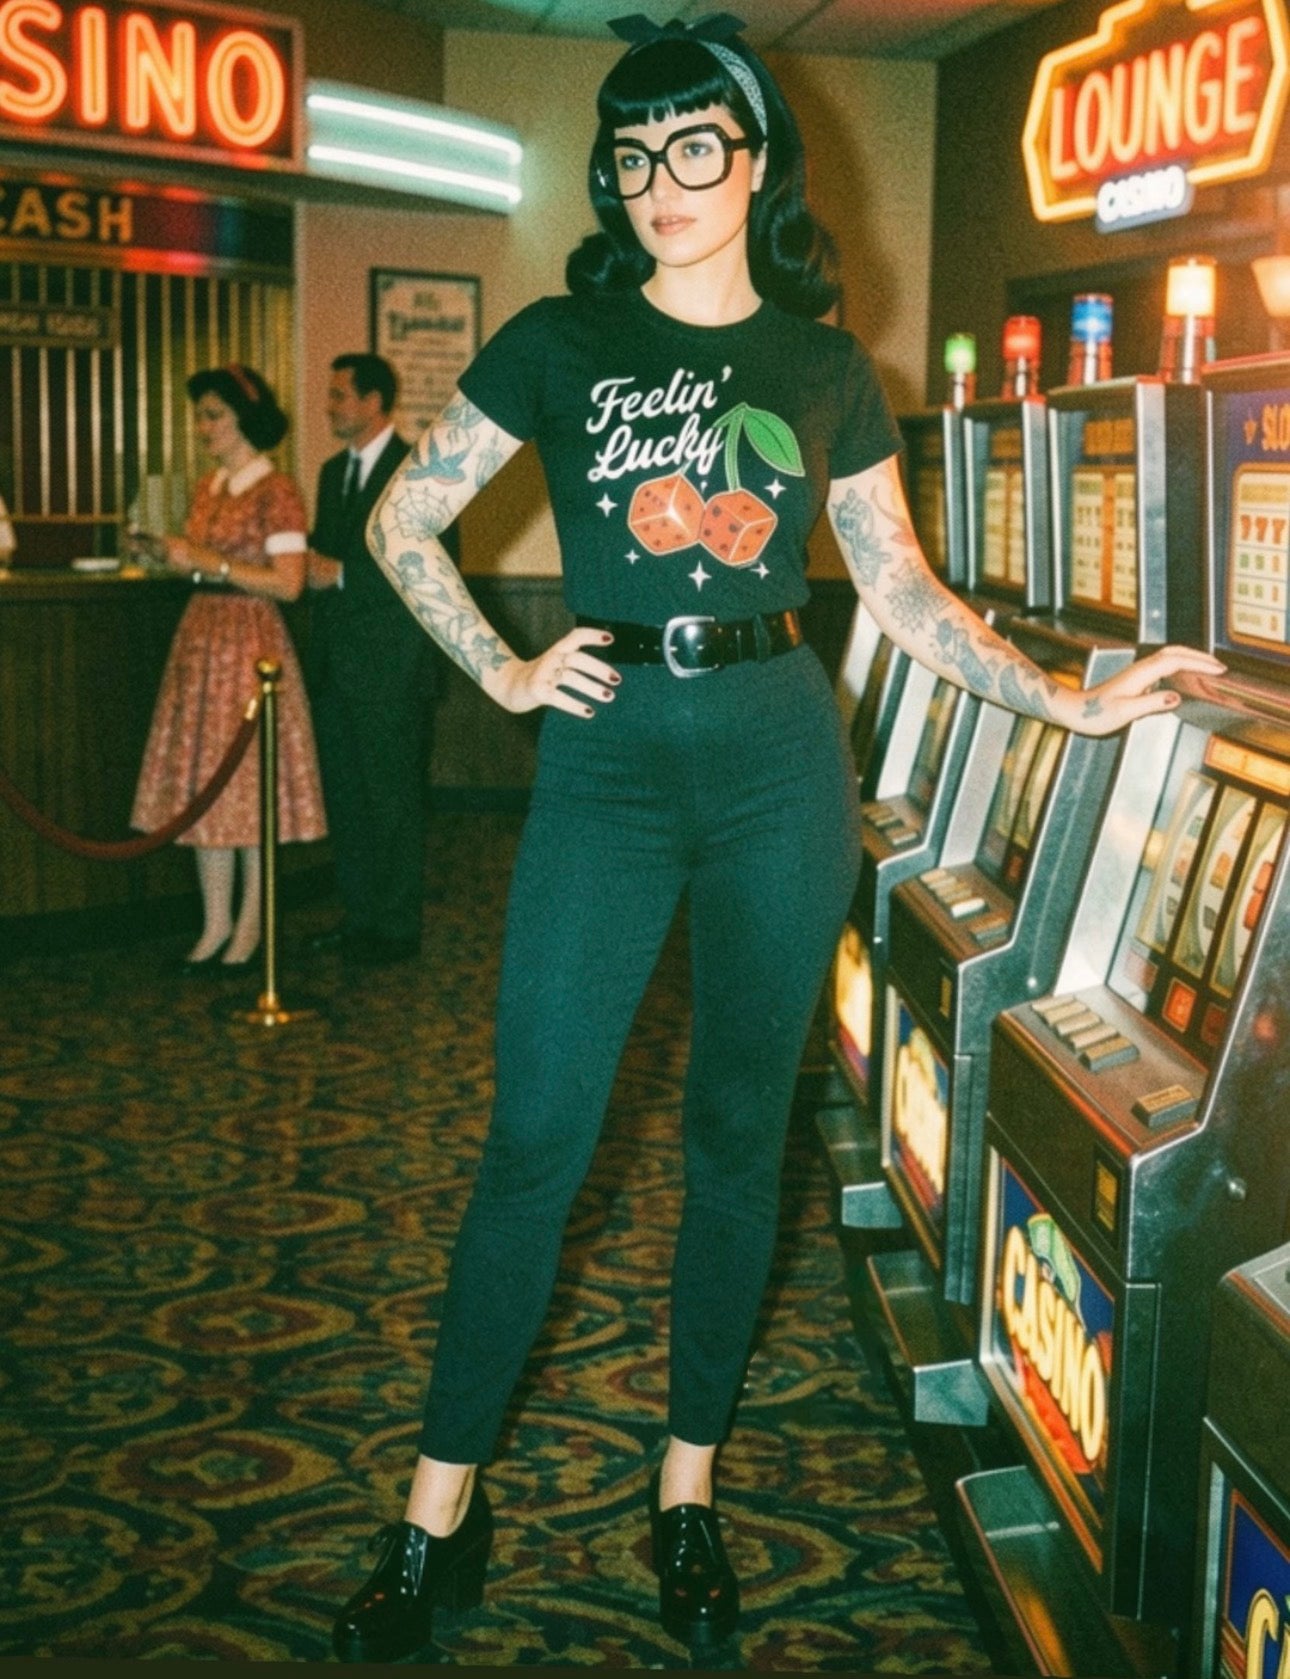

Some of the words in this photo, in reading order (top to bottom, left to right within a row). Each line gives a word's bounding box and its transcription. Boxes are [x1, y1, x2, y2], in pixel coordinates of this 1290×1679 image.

[0, 0, 285, 147] SINO
[1051, 15, 1262, 181] LOUNGE
[0, 186, 134, 243] ASH
[586, 365, 732, 434] Feelin'
[587, 413, 724, 483] Lucky
[1003, 1225, 1106, 1461] CASINO
